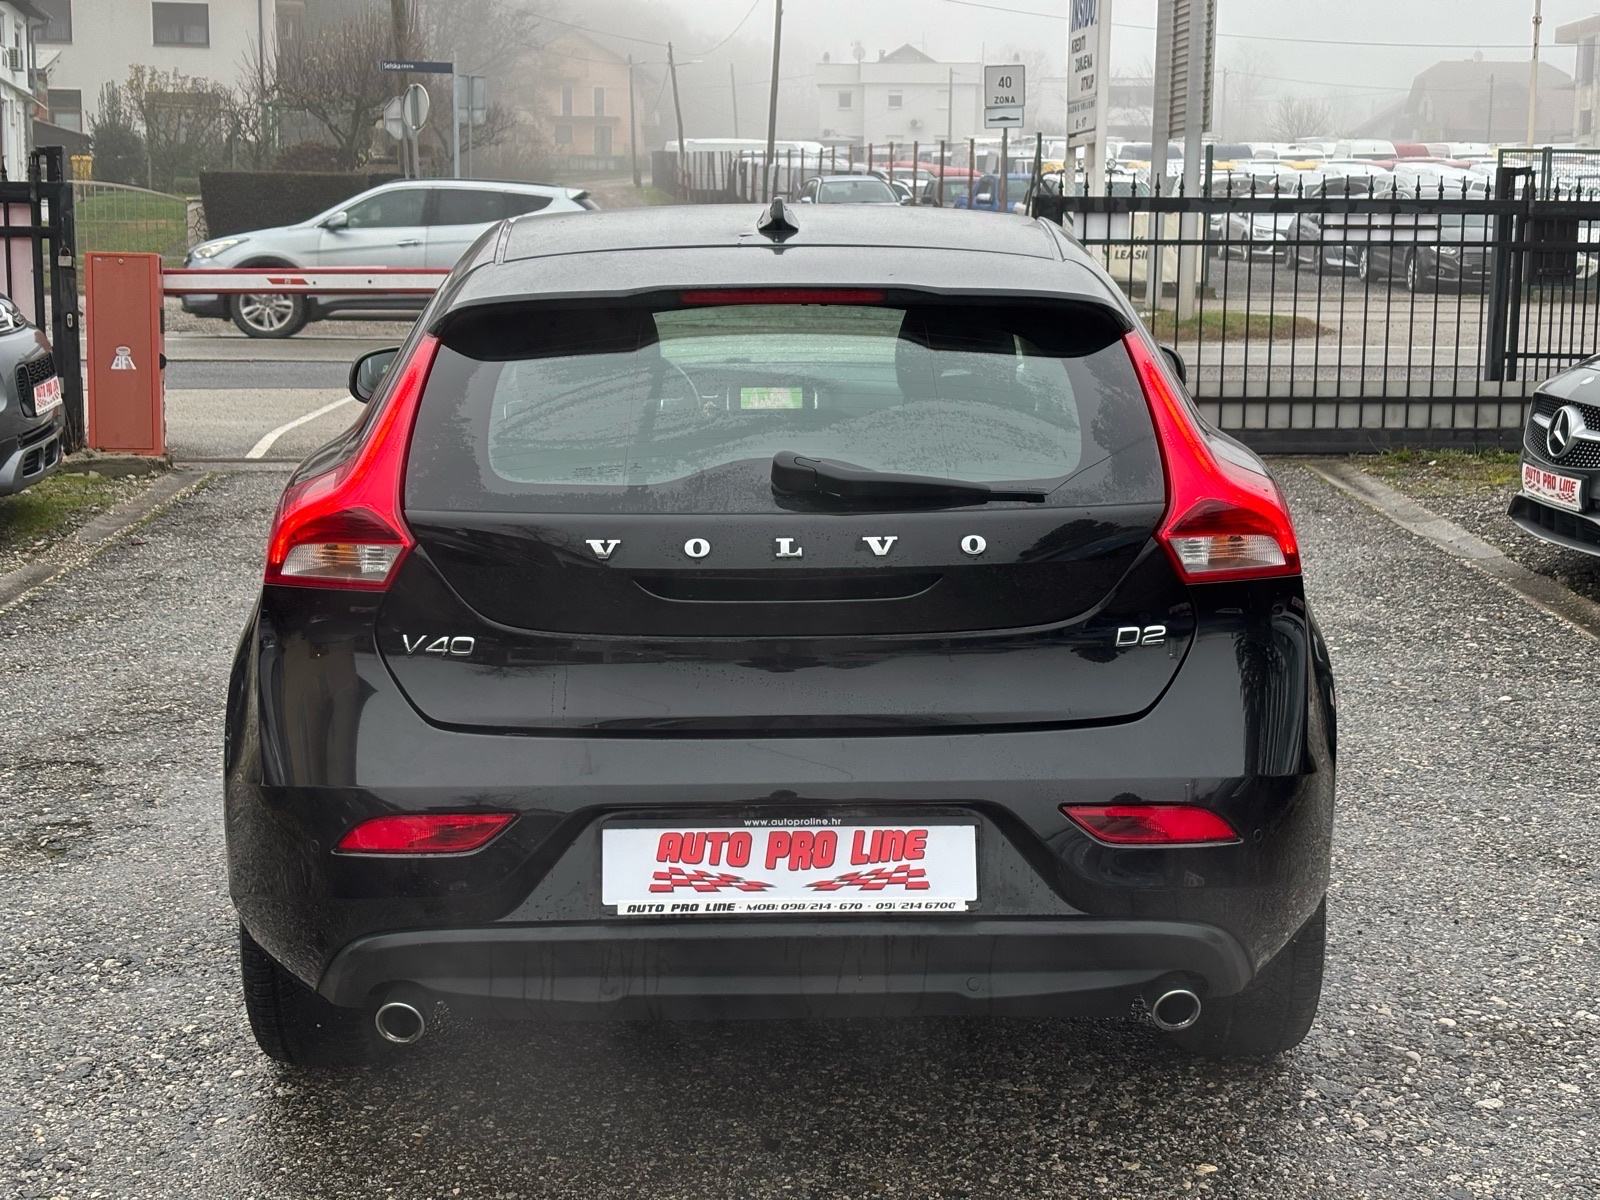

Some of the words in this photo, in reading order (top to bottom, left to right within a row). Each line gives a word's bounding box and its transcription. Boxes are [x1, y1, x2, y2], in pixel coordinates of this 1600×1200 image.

[998, 76, 1012, 88] 40
[993, 95, 1016, 104] ZONA
[1525, 466, 1541, 484] AUTO
[1542, 473, 1556, 490] PRO
[1559, 477, 1576, 493] LINE
[586, 535, 987, 559] VOLVO
[402, 634, 475, 656] V40
[1115, 625, 1166, 647] D2
[743, 817, 842, 827] www.autoproline.hr
[656, 831, 753, 868] AUTO
[765, 830, 839, 872] PRO
[850, 829, 929, 866] LINE
[627, 903, 665, 913] AUTO
[671, 903, 700, 912] PRO
[705, 902, 736, 912] LINE
